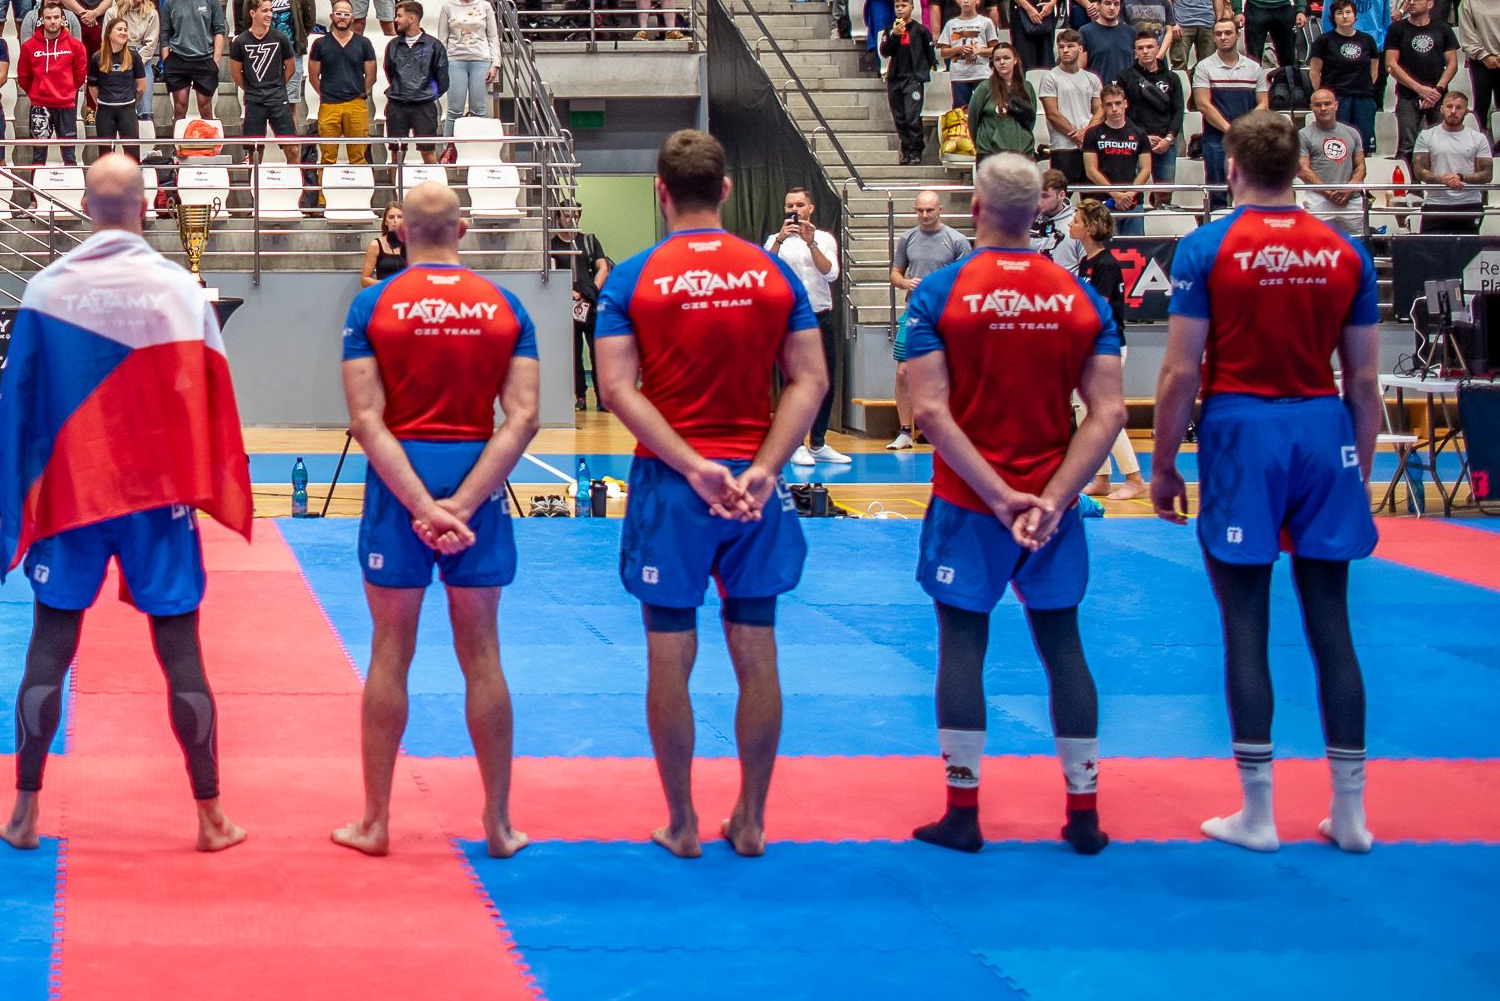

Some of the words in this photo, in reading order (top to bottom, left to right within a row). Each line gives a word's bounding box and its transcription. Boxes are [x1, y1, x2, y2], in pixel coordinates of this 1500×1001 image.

[1097, 141, 1138, 150] GROUND
[1233, 248, 1342, 270] TATAMY
[653, 270, 768, 295] TATAMY
[1259, 278, 1284, 286] CZE
[1288, 277, 1327, 285] TEAM
[392, 301, 499, 321] TATAMY
[681, 301, 709, 310] CZE
[712, 299, 753, 307] TEAM
[963, 292, 1076, 314] TATAMY
